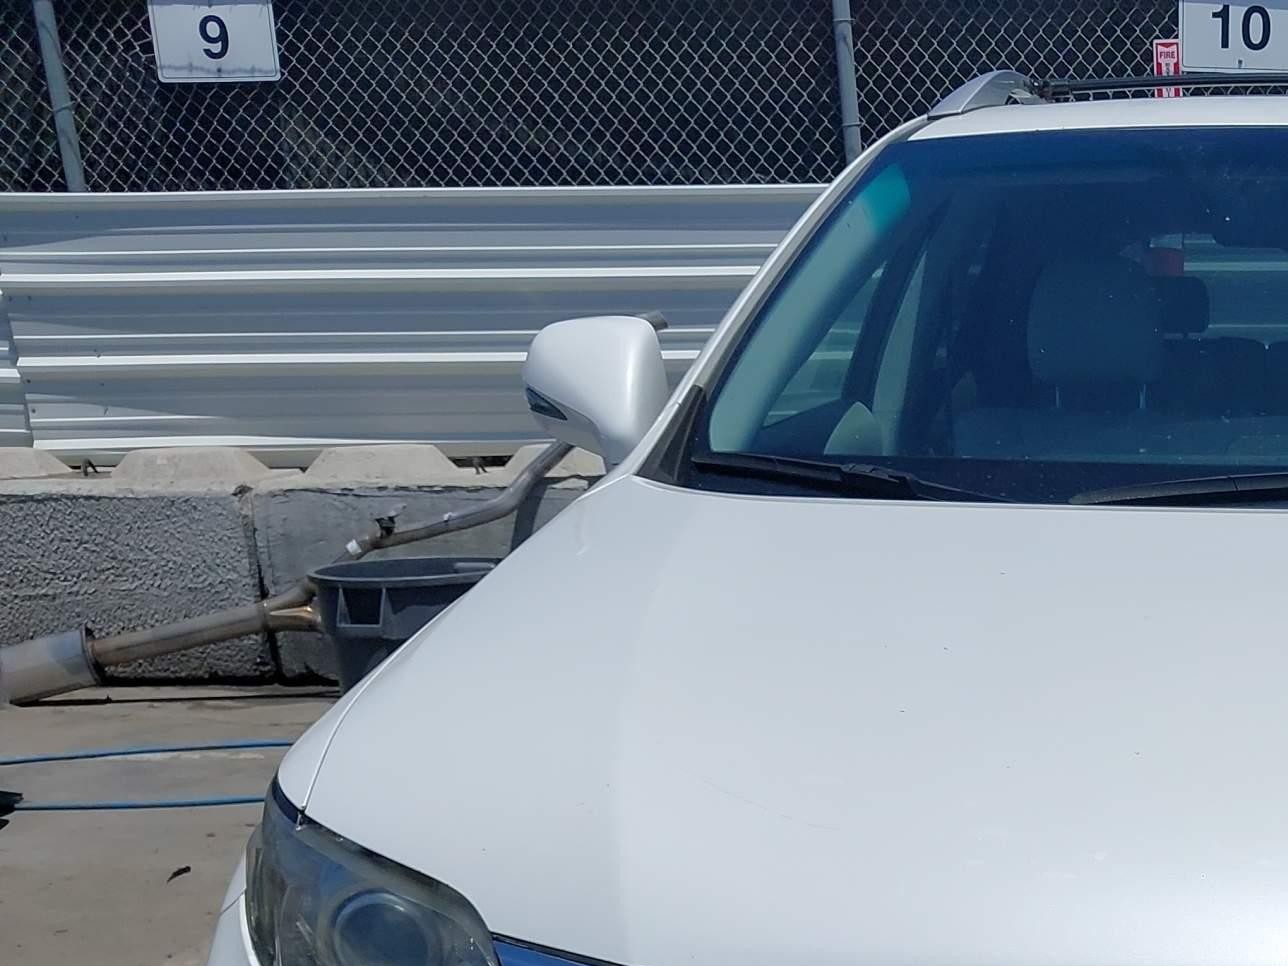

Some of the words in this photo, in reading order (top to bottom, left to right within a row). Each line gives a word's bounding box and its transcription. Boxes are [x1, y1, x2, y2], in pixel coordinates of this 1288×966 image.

[198, 15, 229, 59] 9
[1211, 4, 1271, 50] 10
[1159, 51, 1176, 59] FIRE
